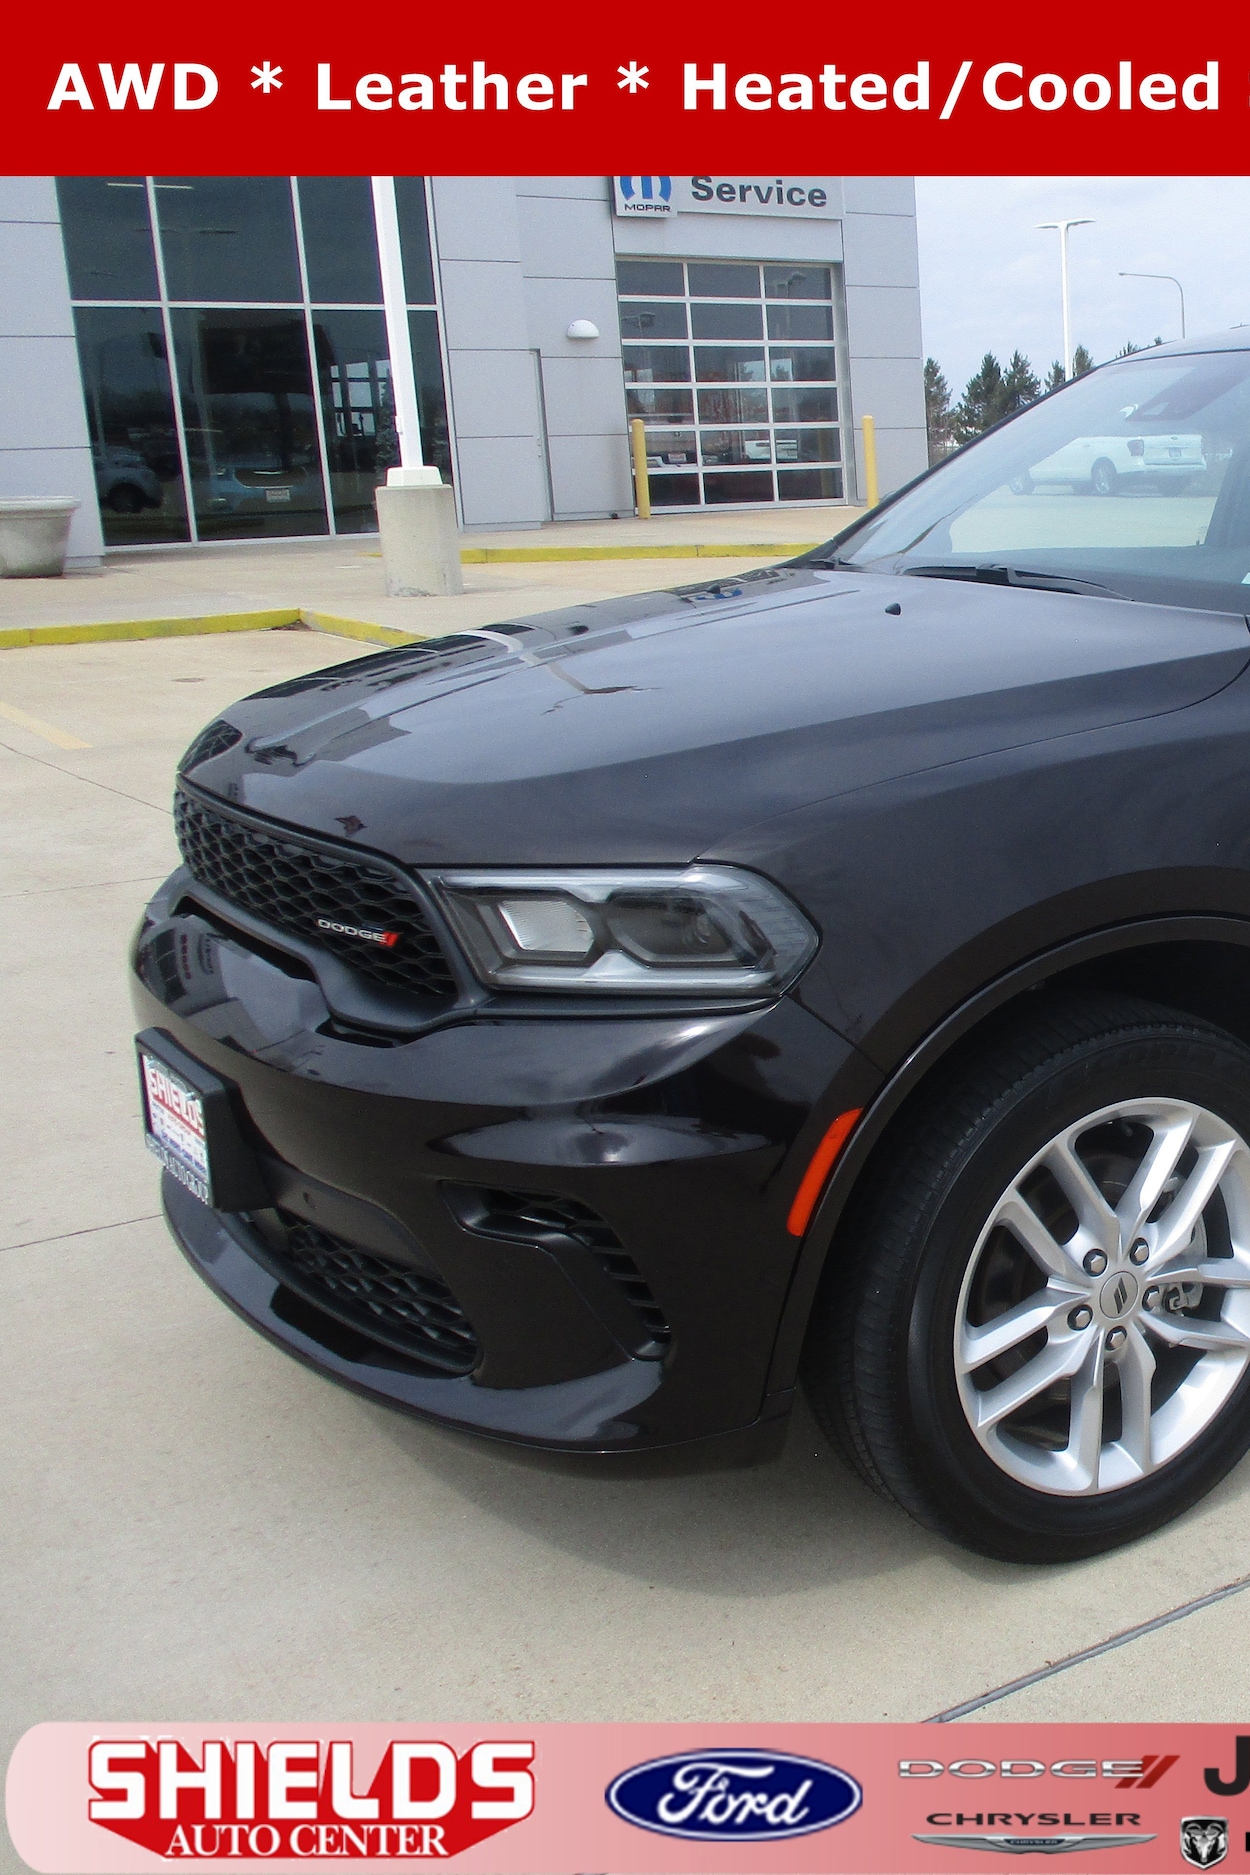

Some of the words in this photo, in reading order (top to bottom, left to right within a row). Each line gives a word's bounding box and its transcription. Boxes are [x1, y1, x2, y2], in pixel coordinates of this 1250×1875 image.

[691, 175, 827, 208] Service
[624, 203, 671, 212] MOPAR
[318, 918, 388, 943] DODGE
[148, 1068, 206, 1138] SHIELDS
